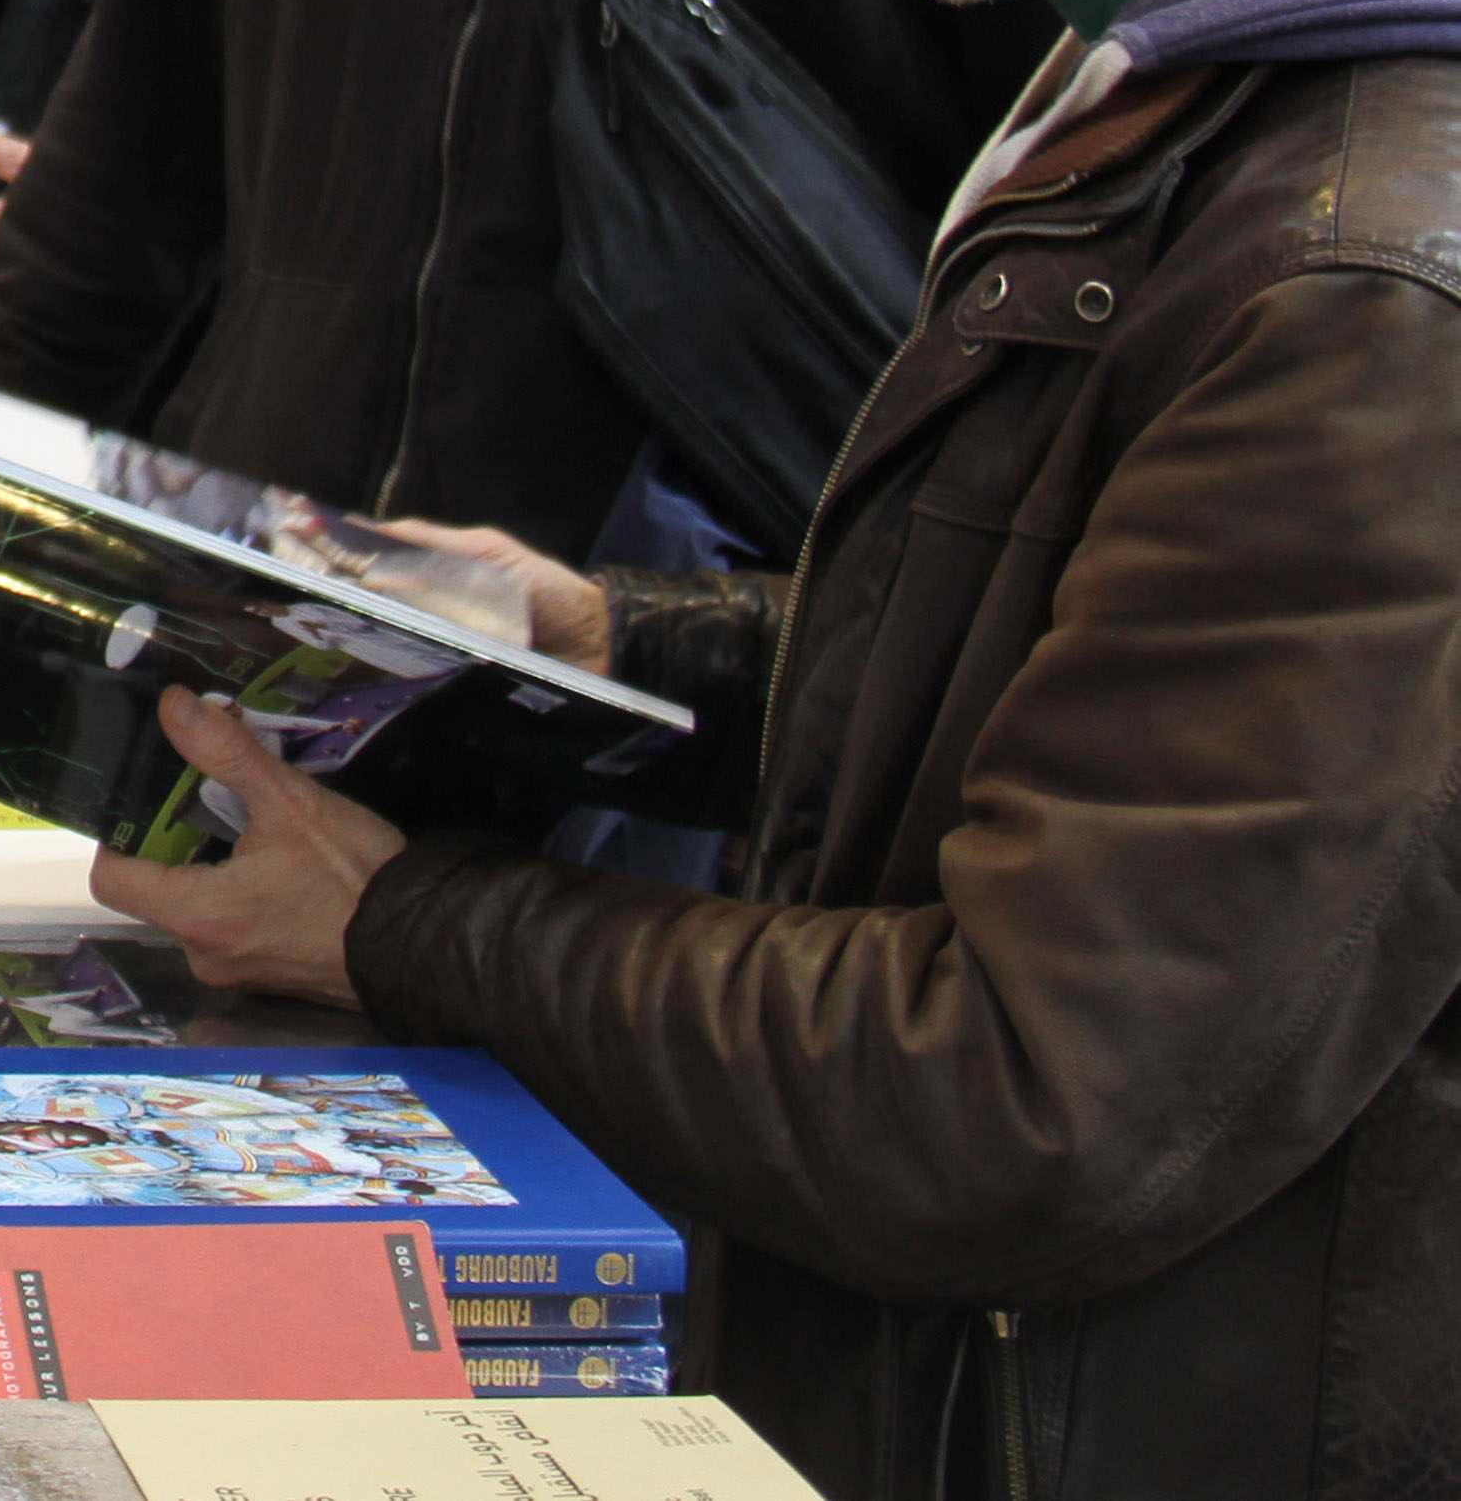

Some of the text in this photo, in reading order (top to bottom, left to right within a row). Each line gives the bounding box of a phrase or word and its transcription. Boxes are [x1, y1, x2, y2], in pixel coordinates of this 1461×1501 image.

[455, 1255, 557, 1284] FAUBOURG
[20, 1273, 52, 1362] LESSONS
[408, 1300, 422, 1311] T
[448, 1300, 531, 1328] FAUBOU
[413, 1321, 430, 1342] BY
[465, 1357, 540, 1385] FAUBOU
[424, 1409, 483, 1429] آخر
[462, 1431, 507, 1466] حروب
[471, 1409, 550, 1447] أنقاض
